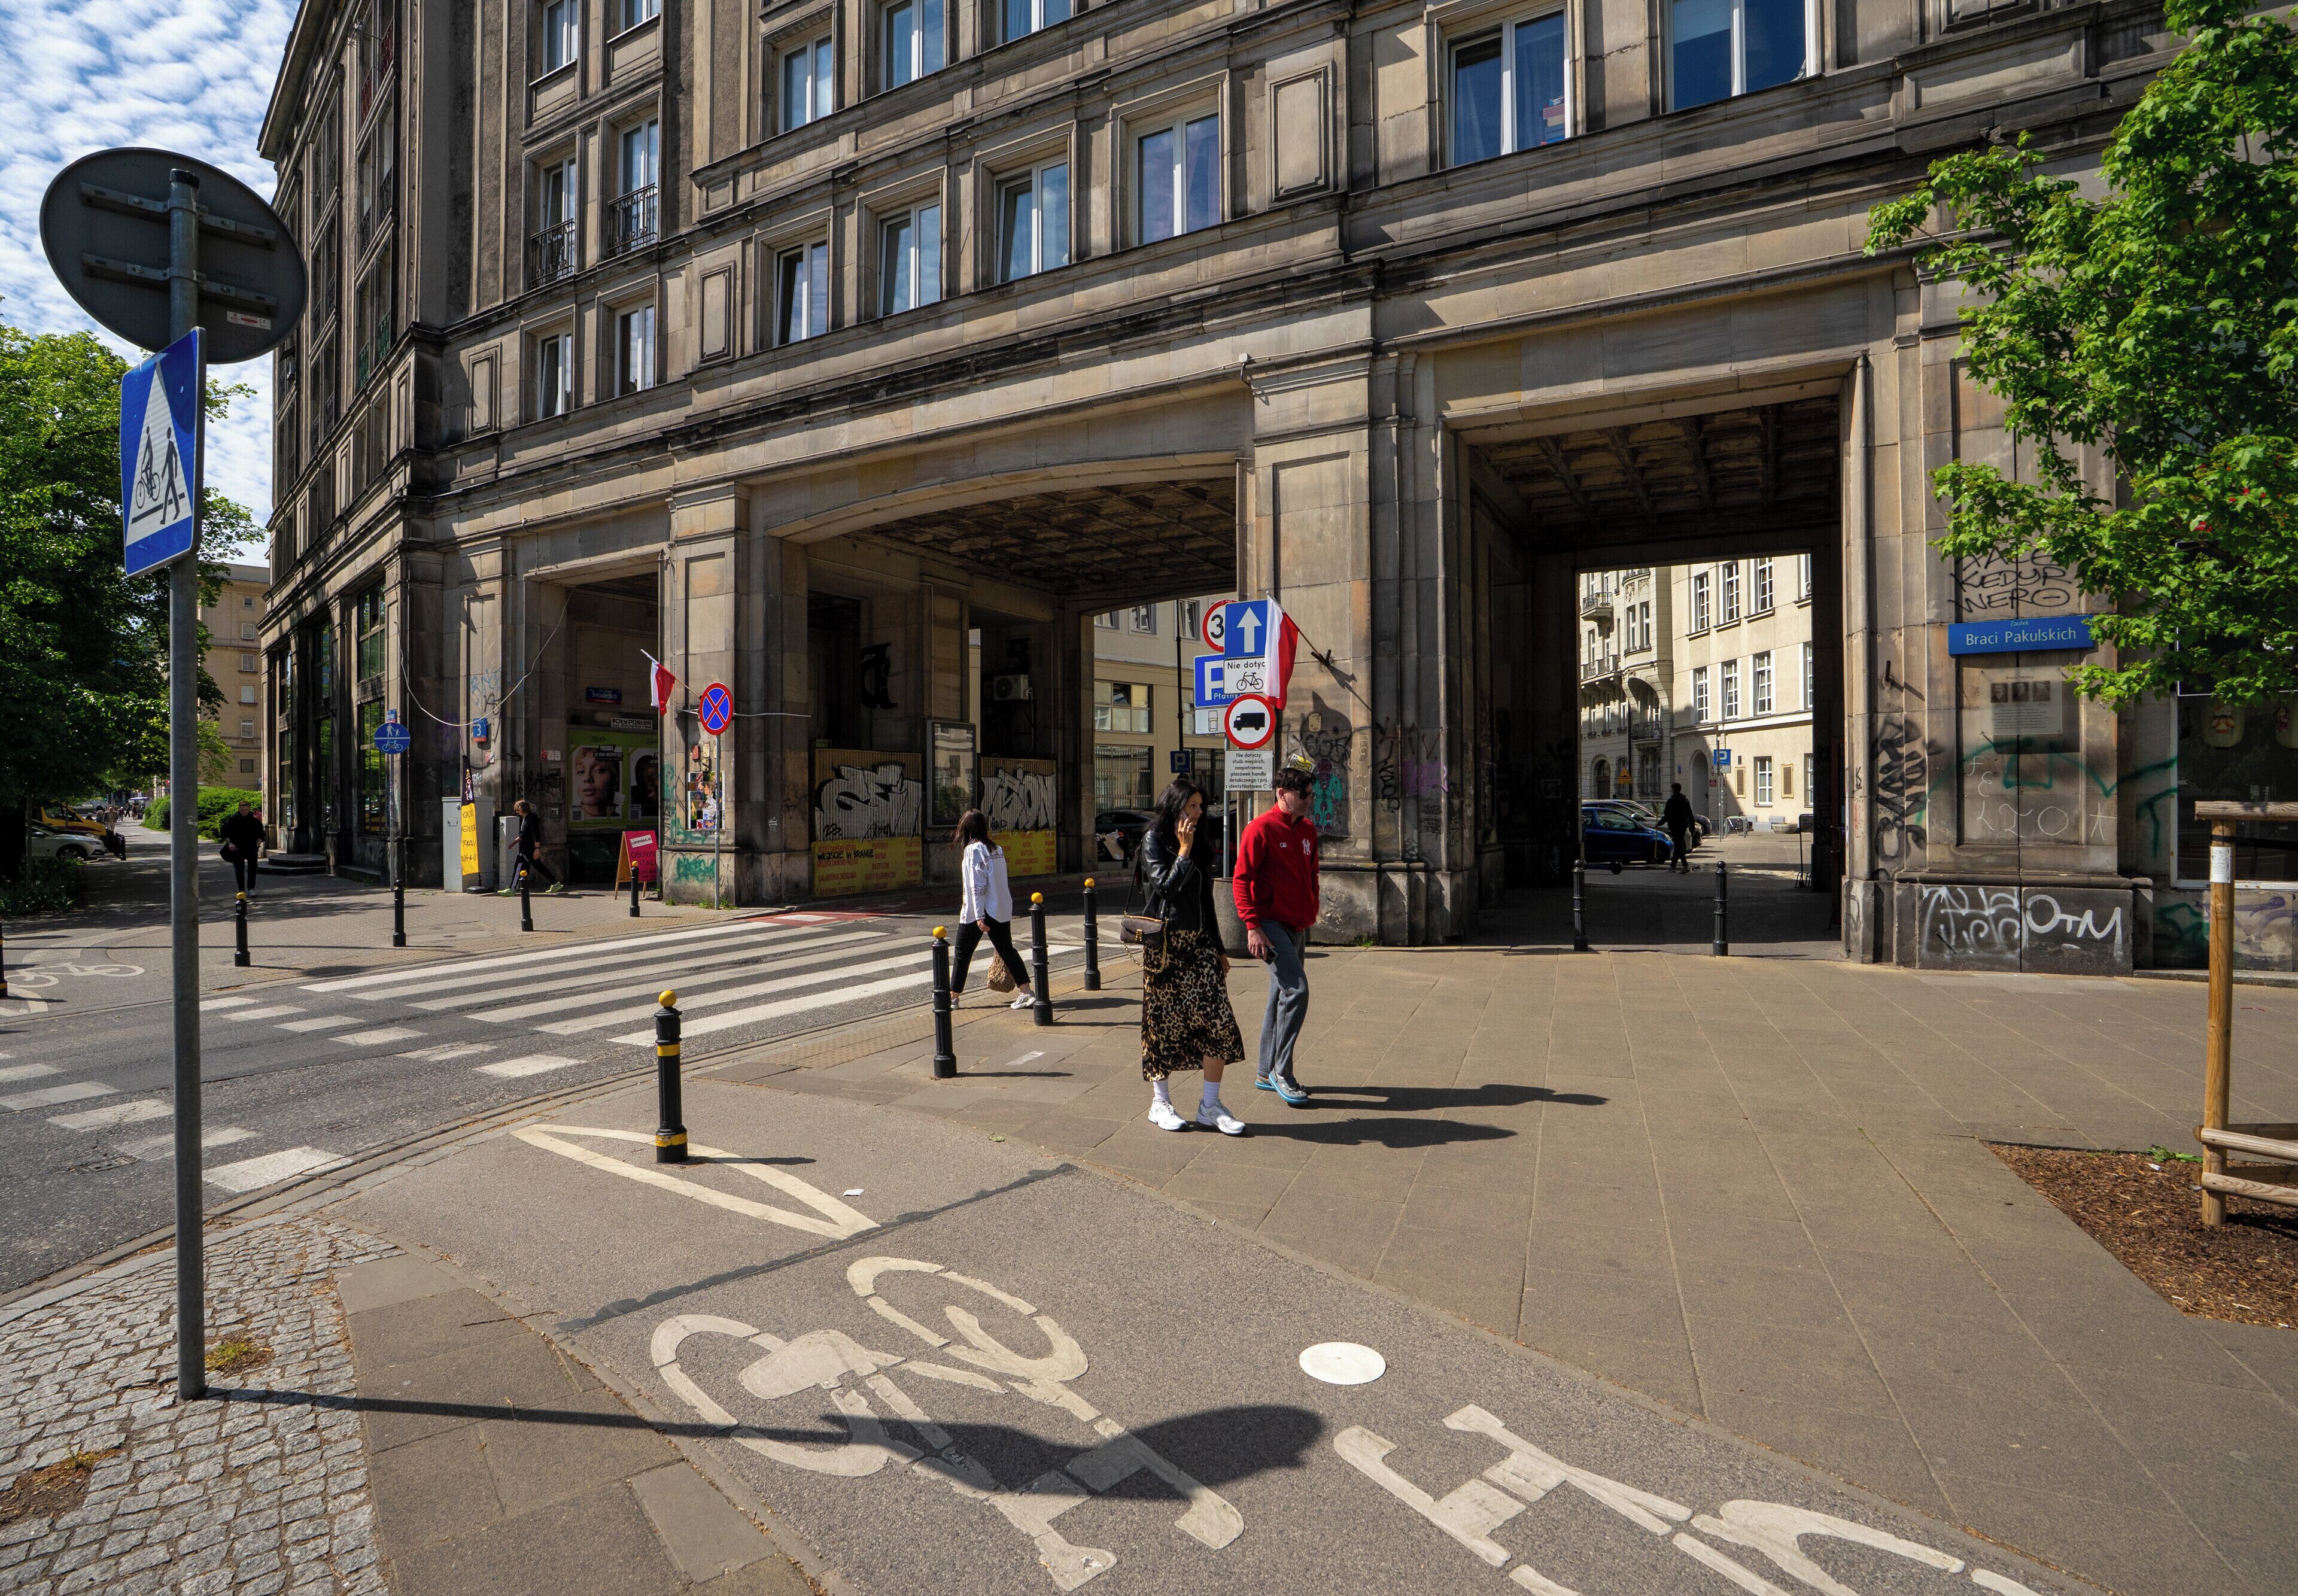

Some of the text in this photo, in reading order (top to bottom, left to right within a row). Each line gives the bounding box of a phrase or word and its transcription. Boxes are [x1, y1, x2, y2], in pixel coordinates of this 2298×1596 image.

[1211, 614, 1224, 639] 3
[1966, 627, 2077, 646] Braci Pakulskich
[1244, 661, 1265, 670] dotyc
[477, 724, 481, 736] 3
[1175, 753, 1186, 771] P
[846, 850, 852, 859] W
[853, 849, 874, 858] BRAMIE
